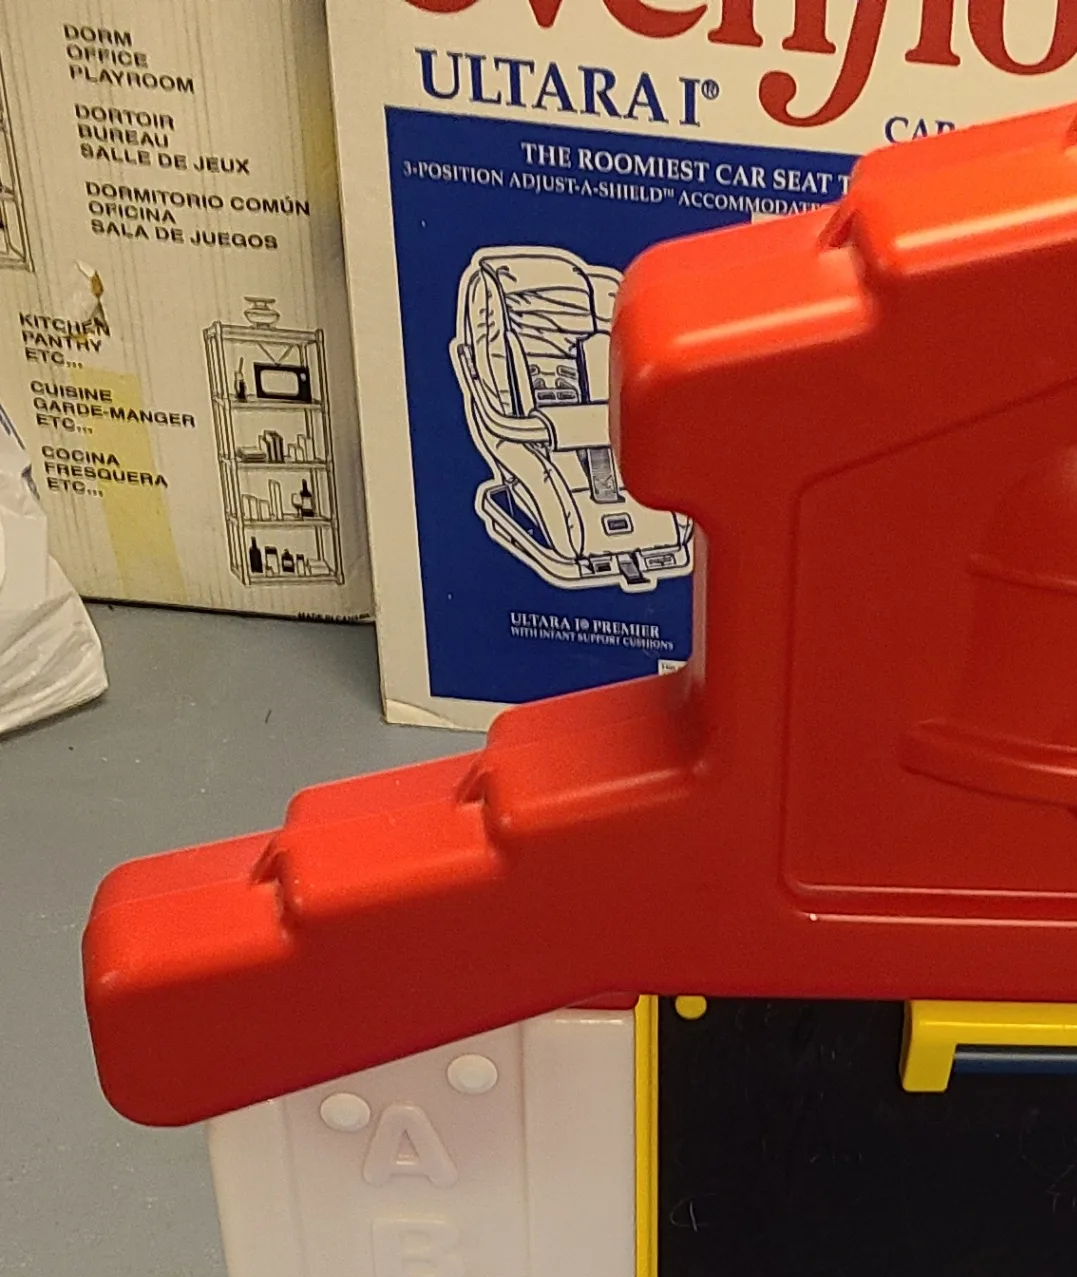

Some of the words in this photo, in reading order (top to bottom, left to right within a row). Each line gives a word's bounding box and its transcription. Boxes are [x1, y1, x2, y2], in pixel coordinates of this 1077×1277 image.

[63, 24, 133, 46] DORM
[66, 44, 148, 68] OFFICE
[68, 64, 195, 94] PLAYROOM
[416, 48, 669, 124] ULTARA
[74, 103, 175, 131] DORTOIR
[77, 123, 169, 149] BUREAU
[80, 143, 150, 166] SALLE
[158, 152, 187, 171] DE
[193, 155, 250, 176] JEUX
[521, 142, 572, 168] THE
[578, 148, 710, 182] ROOMIEST
[716, 163, 766, 189] CAR
[773, 169, 833, 194] SEAT
[403, 160, 504, 187] 3-POSITION
[85, 181, 223, 209] DORMITORIO
[230, 195, 311, 216] COMÚN
[88, 201, 176, 224] OFICINA
[91, 219, 149, 240] SALA
[155, 227, 184, 244] DE
[190, 231, 278, 250] JUEGOS
[19, 312, 111, 337] KITCHEN
[22, 330, 103, 352] PANTRY
[30, 380, 113, 403] CUISINE
[33, 397, 196, 428] GARDE-MANGER
[41, 445, 120, 466] COCINA
[44, 461, 168, 489] FRESQUERA
[510, 612, 570, 630] ULTARA
[593, 620, 660, 638] PREMIER
[511, 626, 537, 638] WITH
[540, 628, 575, 642] INFANT
[578, 632, 620, 646] SUPPORT
[623, 637, 674, 650] CUSHIONS
[362, 1101, 459, 1190] A
